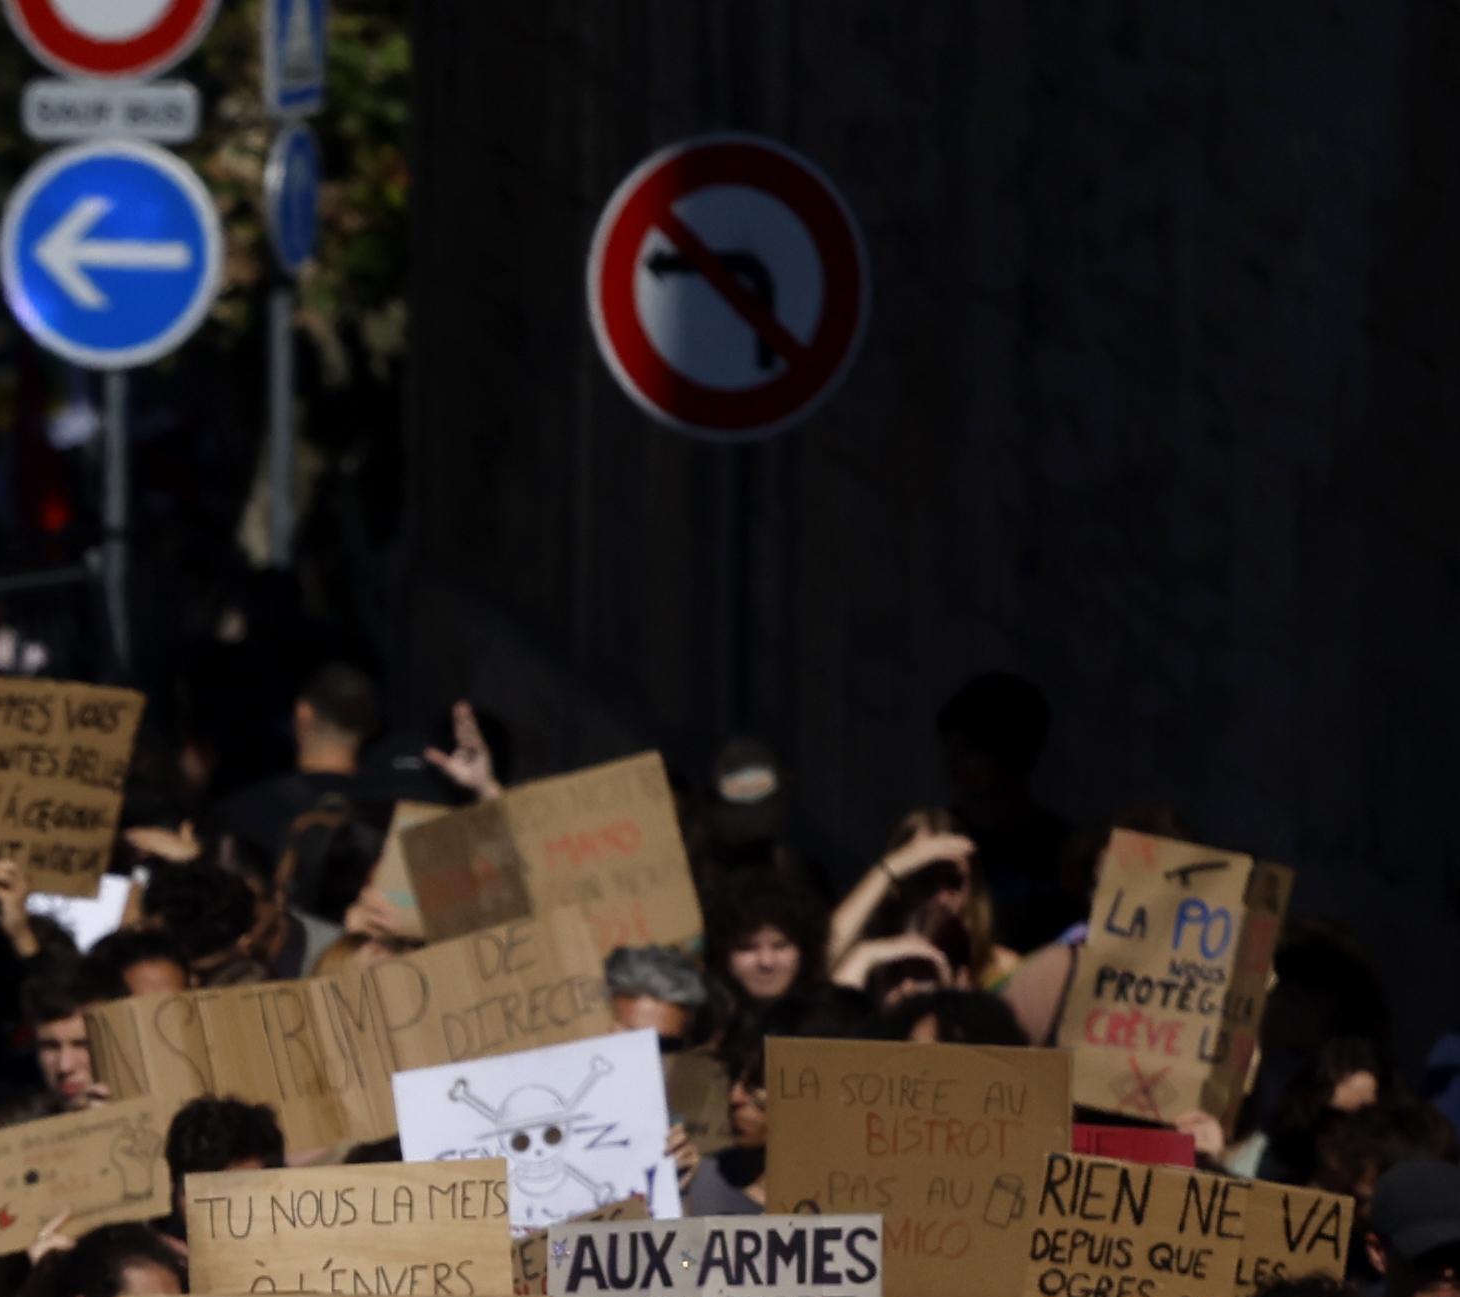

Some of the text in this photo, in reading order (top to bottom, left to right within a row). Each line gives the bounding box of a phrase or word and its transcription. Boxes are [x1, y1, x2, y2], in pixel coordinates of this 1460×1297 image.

[778, 1063, 821, 1101] LA
[865, 1113, 1020, 1161] BISTROT
[194, 1196, 253, 1239] TU
[272, 1189, 357, 1234] NOUS
[371, 1184, 414, 1222] LA
[429, 1180, 509, 1221] METS
[826, 1169, 904, 1207] PAS
[1041, 1152, 1346, 1260] RIEN NE VA
[566, 1226, 878, 1294] AUX ARMES
[1030, 1229, 1287, 1289] DEPUIS QUE LES
